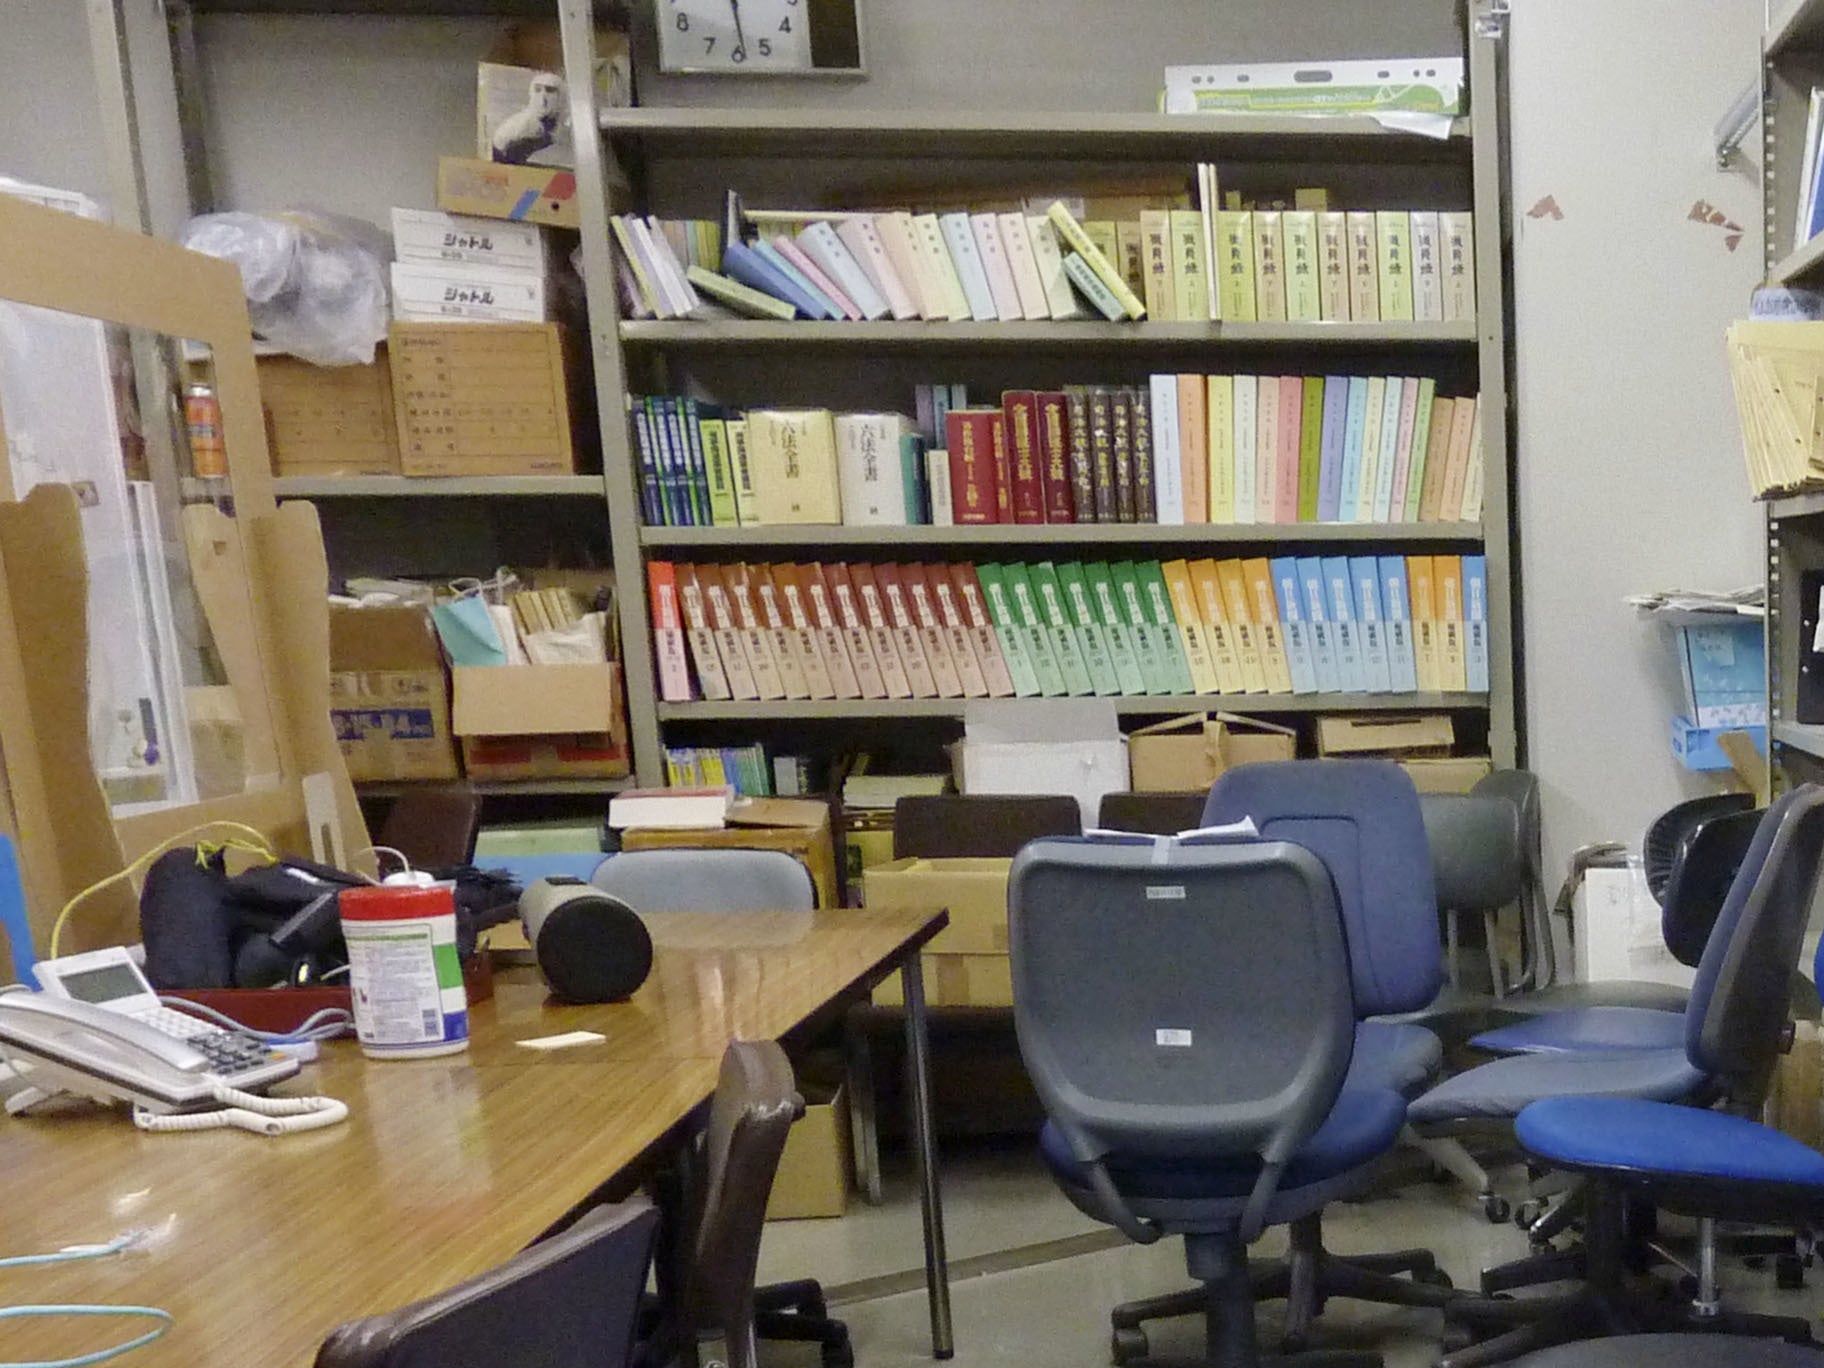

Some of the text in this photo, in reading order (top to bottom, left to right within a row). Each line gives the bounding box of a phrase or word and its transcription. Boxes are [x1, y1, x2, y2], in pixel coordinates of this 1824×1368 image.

[676, 13, 690, 32] 8
[778, 17, 792, 33] 4
[703, 38, 717, 55] 7
[758, 39, 772, 57] 5
[443, 232, 494, 251] シャトル
[443, 287, 495, 306] シャトル
[780, 419, 800, 479] 六法全書
[860, 423, 879, 482] 六法全書
